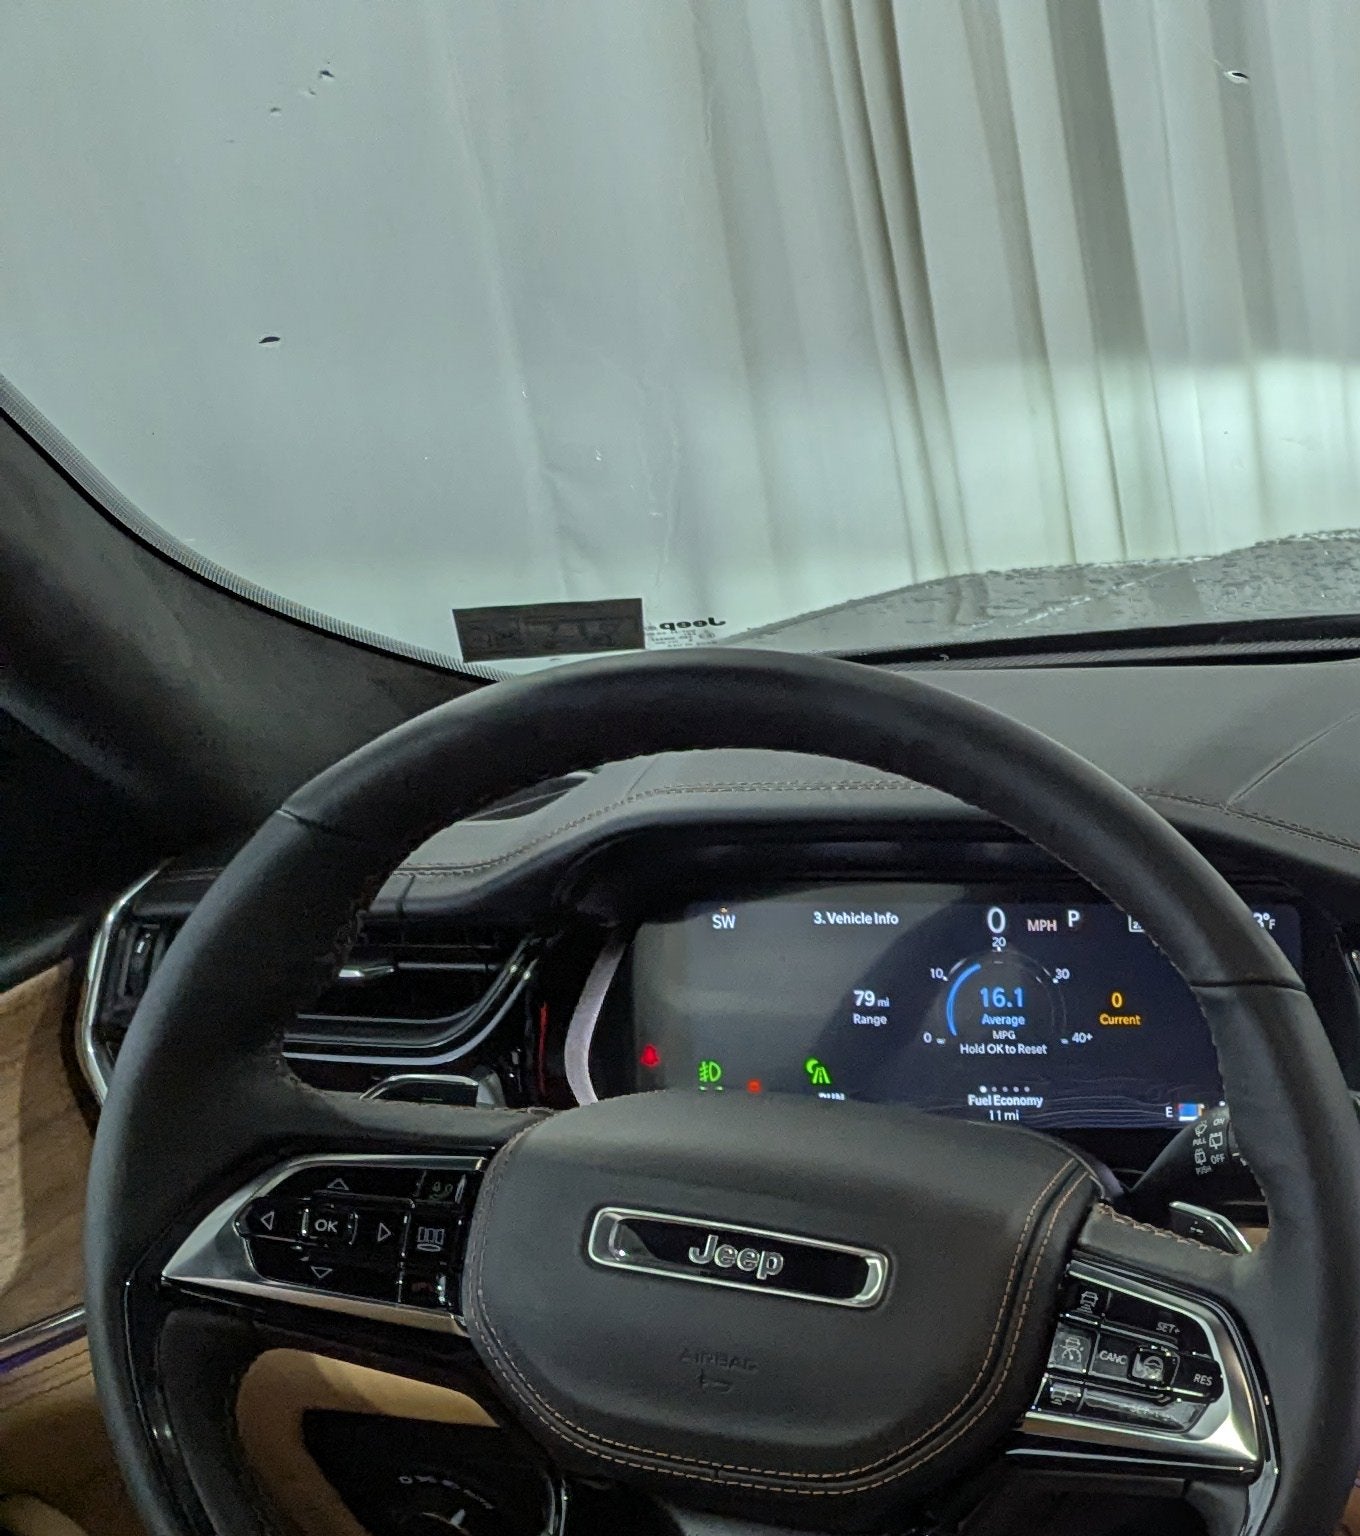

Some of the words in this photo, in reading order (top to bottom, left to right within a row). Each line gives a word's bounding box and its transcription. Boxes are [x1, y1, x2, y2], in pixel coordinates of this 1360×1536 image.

[712, 914, 736, 929] SW
[813, 911, 825, 925] 3.
[826, 911, 872, 925] Vehicle
[874, 911, 899, 925] Info
[987, 906, 1006, 933] 0
[1027, 919, 1057, 932] MPH
[1067, 909, 1080, 928] P
[992, 937, 1006, 947] 20
[930, 968, 944, 979] 10
[1055, 968, 1070, 979] 30
[853, 990, 875, 1007] 79
[877, 997, 889, 1007] mi
[979, 987, 1024, 1008] 16.1
[1111, 992, 1122, 1008] 0
[853, 1013, 887, 1027] Range
[981, 1014, 1025, 1027] Average
[1099, 1014, 1140, 1025] Current
[923, 1032, 932, 1043] 0
[992, 1030, 1016, 1040] MPG
[1071, 1032, 1093, 1044] 40+
[960, 1044, 985, 1055] Hold
[987, 1044, 1003, 1055] OK
[1005, 1045, 1016, 1055] to
[1018, 1044, 1047, 1055] Reset
[968, 1094, 991, 1106] Fuel
[993, 1095, 1043, 1108] Economy
[989, 1110, 1002, 1120] 11
[1004, 1109, 1019, 1121] mi
[1165, 1106, 1173, 1118] E
[1210, 1153, 1225, 1164] OFF
[315, 1218, 338, 1234] OK
[688, 1233, 784, 1279] Jeep
[1100, 1350, 1127, 1365] CANC
[1193, 1373, 1213, 1386] RES
